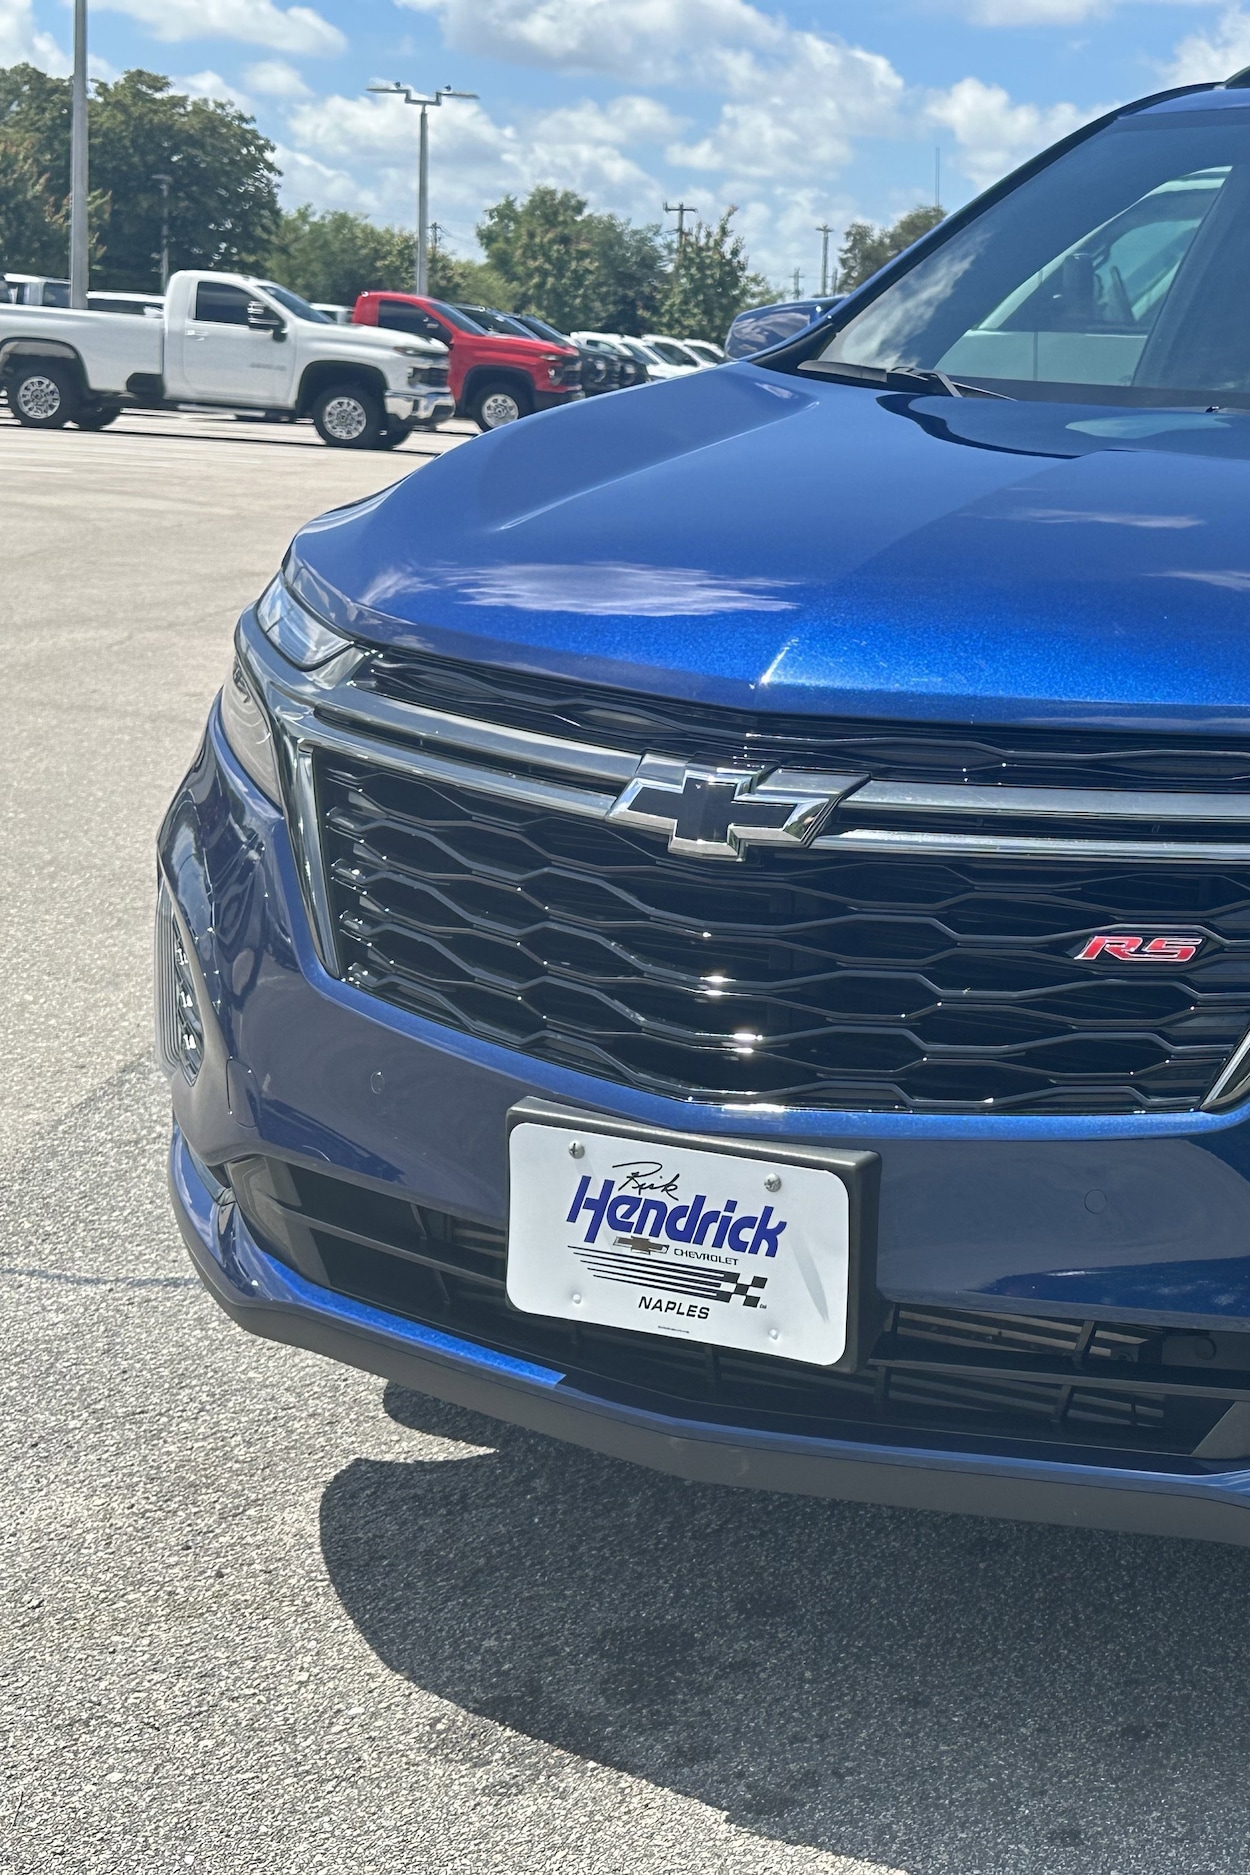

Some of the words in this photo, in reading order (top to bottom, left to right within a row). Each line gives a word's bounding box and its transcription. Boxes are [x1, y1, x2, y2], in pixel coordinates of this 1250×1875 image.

[1074, 935, 1203, 963] RS
[566, 1174, 788, 1258] Hendrick
[673, 1247, 739, 1267] CHEVROLET
[638, 1296, 710, 1320] NAPLES
